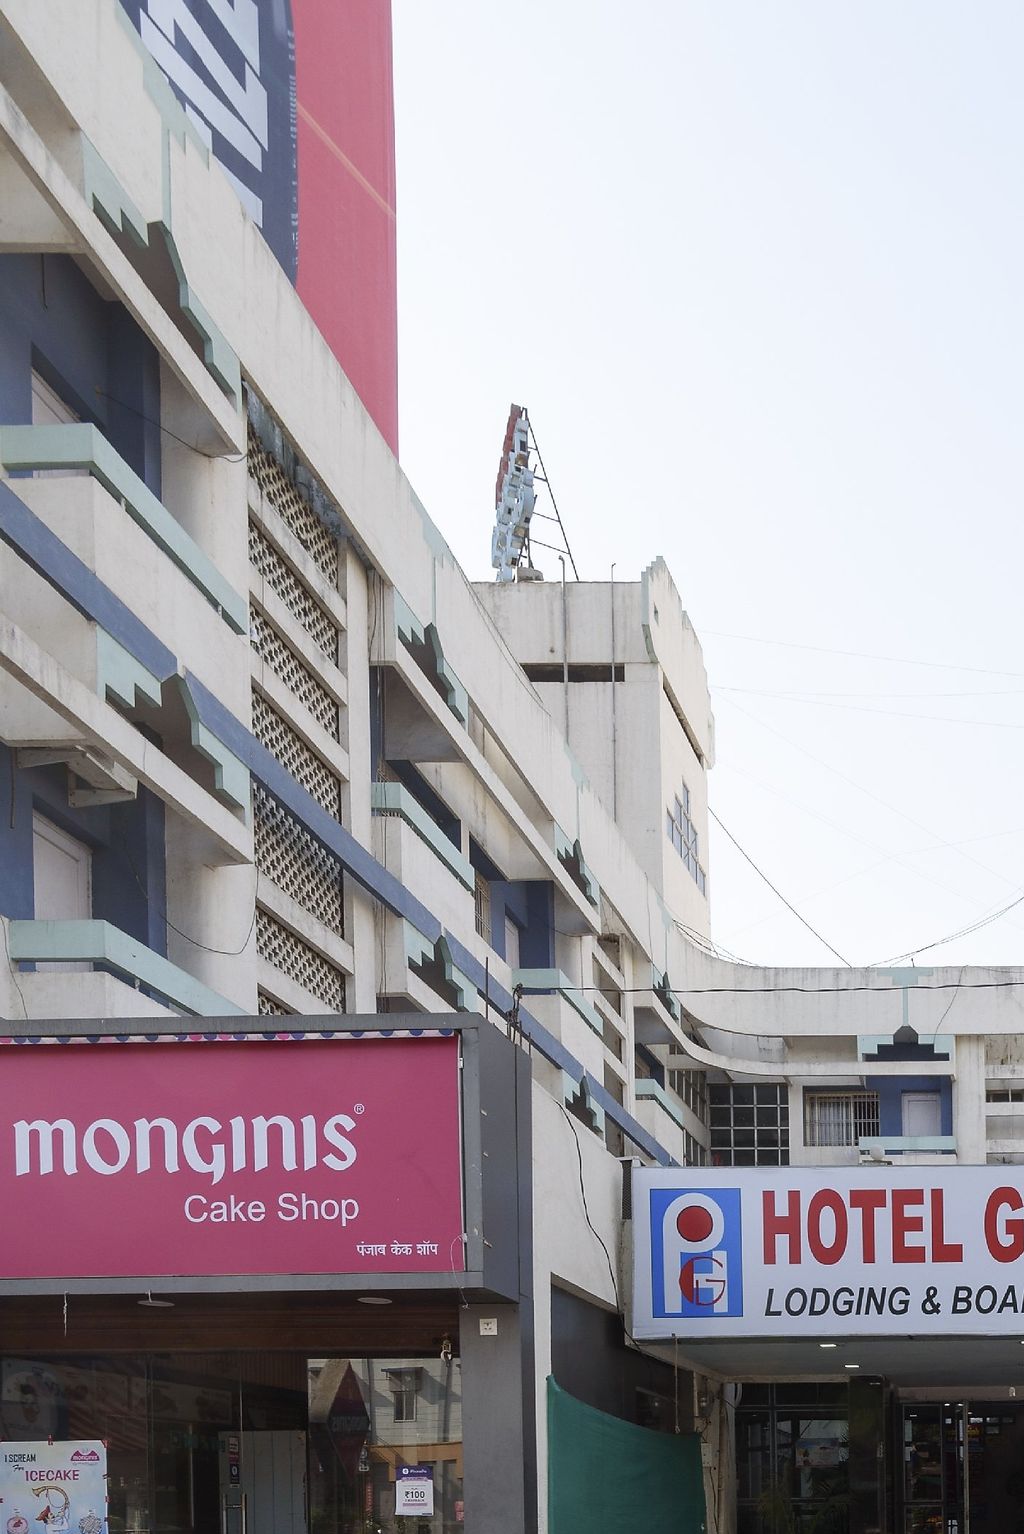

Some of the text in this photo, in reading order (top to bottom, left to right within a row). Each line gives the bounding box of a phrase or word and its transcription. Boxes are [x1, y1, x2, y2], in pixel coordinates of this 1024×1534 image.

[184, 1193, 360, 1226] Cake Shop
[762, 1187, 963, 1265] HOTEL
[356, 1240, 439, 1256] पंजाब केक शॉप
[764, 1286, 911, 1316] LODGING
[921, 1285, 942, 1316] &
[8, 1453, 37, 1463] SCREAM
[25, 1470, 80, 1481] ICECAKE
